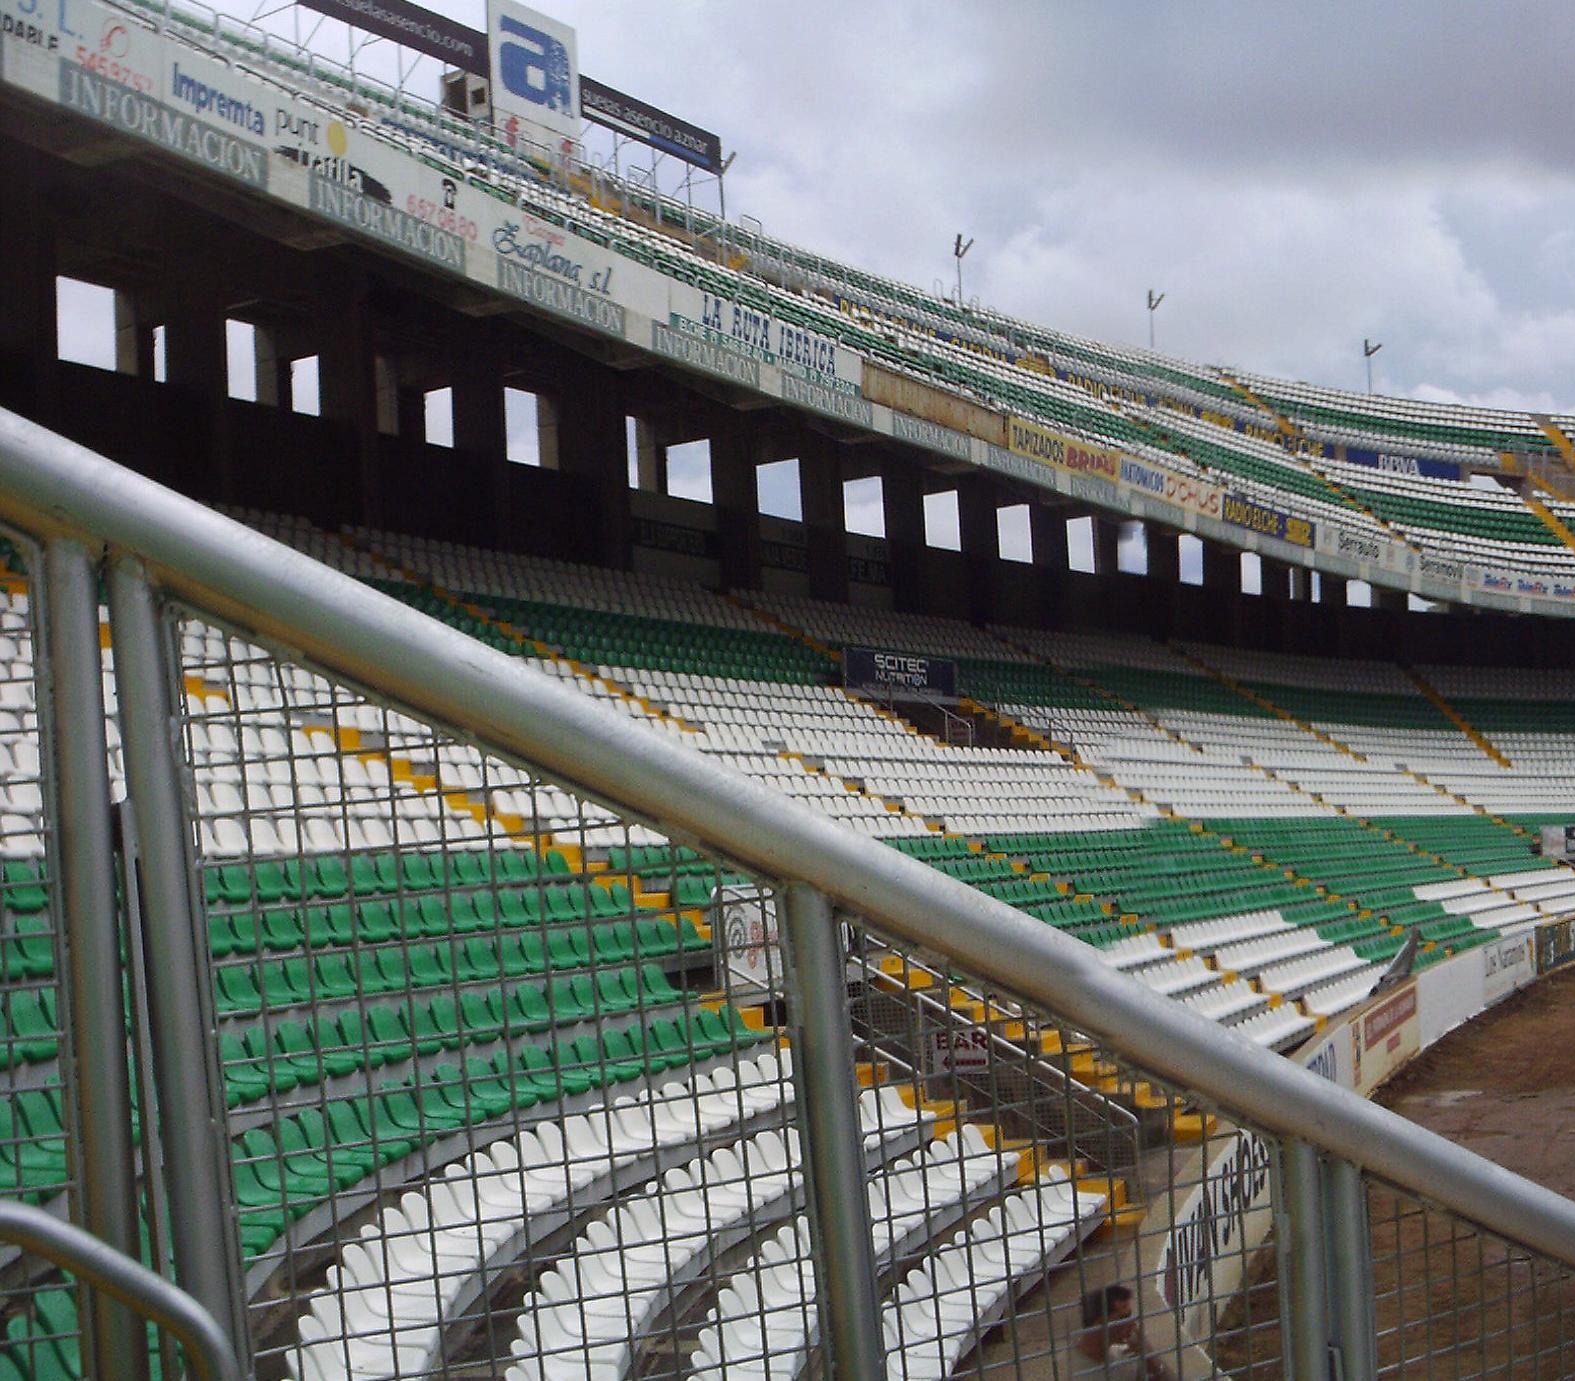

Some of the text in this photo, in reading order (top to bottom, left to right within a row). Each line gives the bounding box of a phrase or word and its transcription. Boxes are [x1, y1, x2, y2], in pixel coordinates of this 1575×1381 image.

[171, 62, 265, 137] Impremta
[873, 653, 928, 673] SCITEC
[874, 672, 928, 686] NUTRITION
[935, 1031, 987, 1050] BAR
